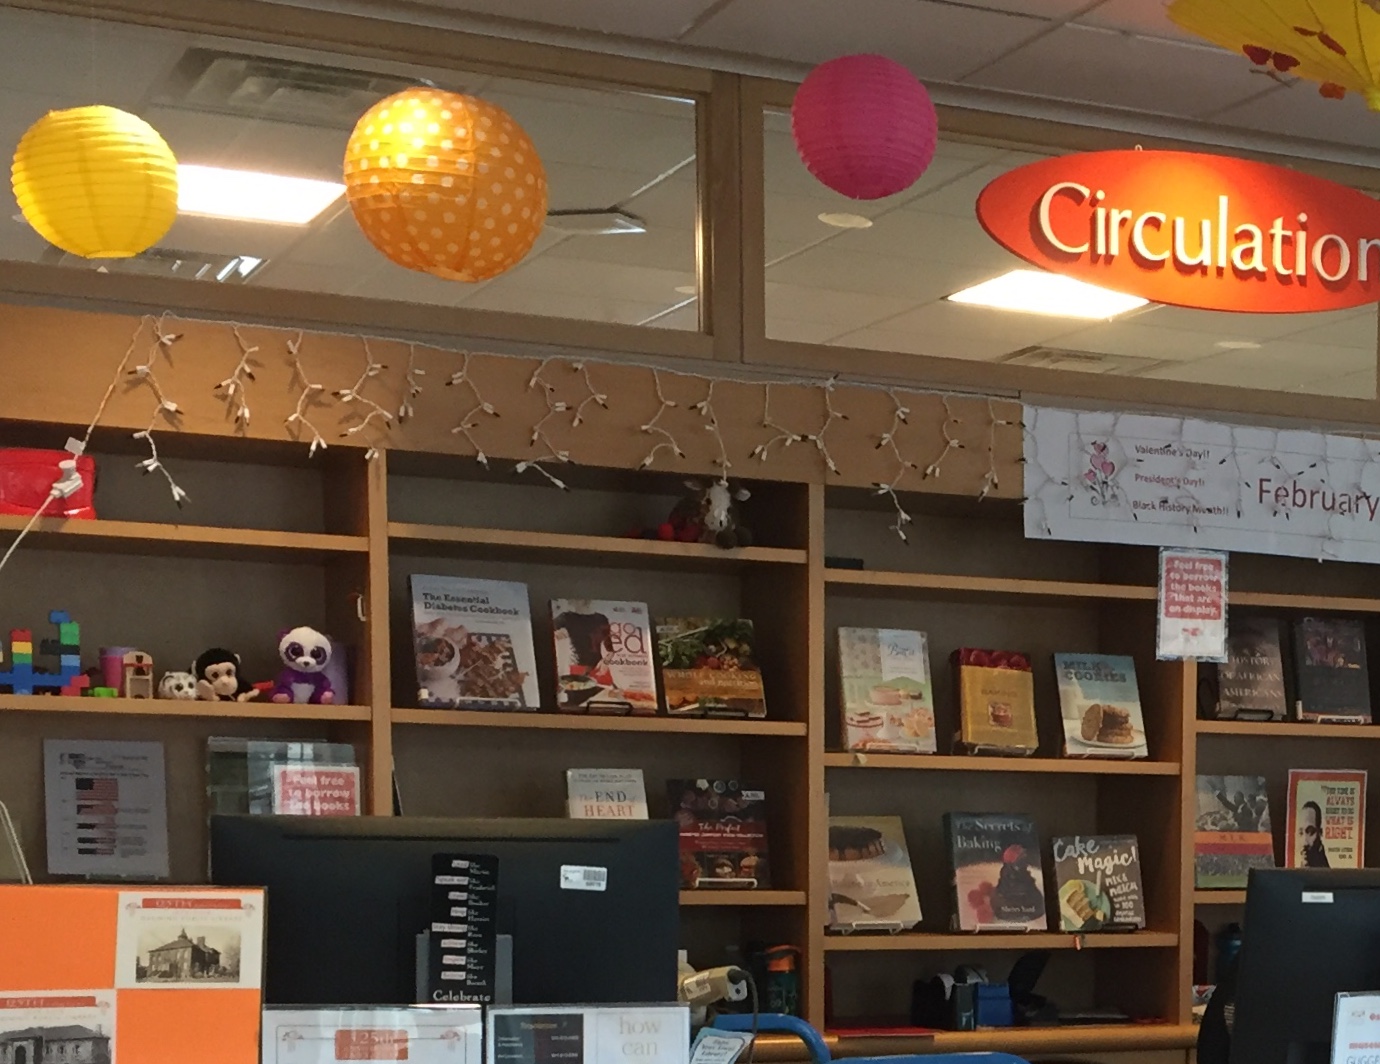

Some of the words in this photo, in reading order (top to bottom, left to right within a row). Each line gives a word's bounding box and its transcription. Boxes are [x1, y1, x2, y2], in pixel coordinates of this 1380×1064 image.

[1258, 478, 1380, 522] February
[444, 593, 489, 604] Essential
[469, 604, 519, 616] Cookbook
[304, 787, 350, 799] borrow
[595, 790, 627, 803] END
[1326, 796, 1355, 807] ALWAYS
[584, 804, 635, 817] HEART
[956, 835, 1002, 852] Baking
[1053, 835, 1100, 862] Cake
[1077, 845, 1137, 875] Magic!
[432, 989, 491, 1002] Celebrate
[618, 1016, 660, 1035] how
[621, 1040, 658, 1056] can
